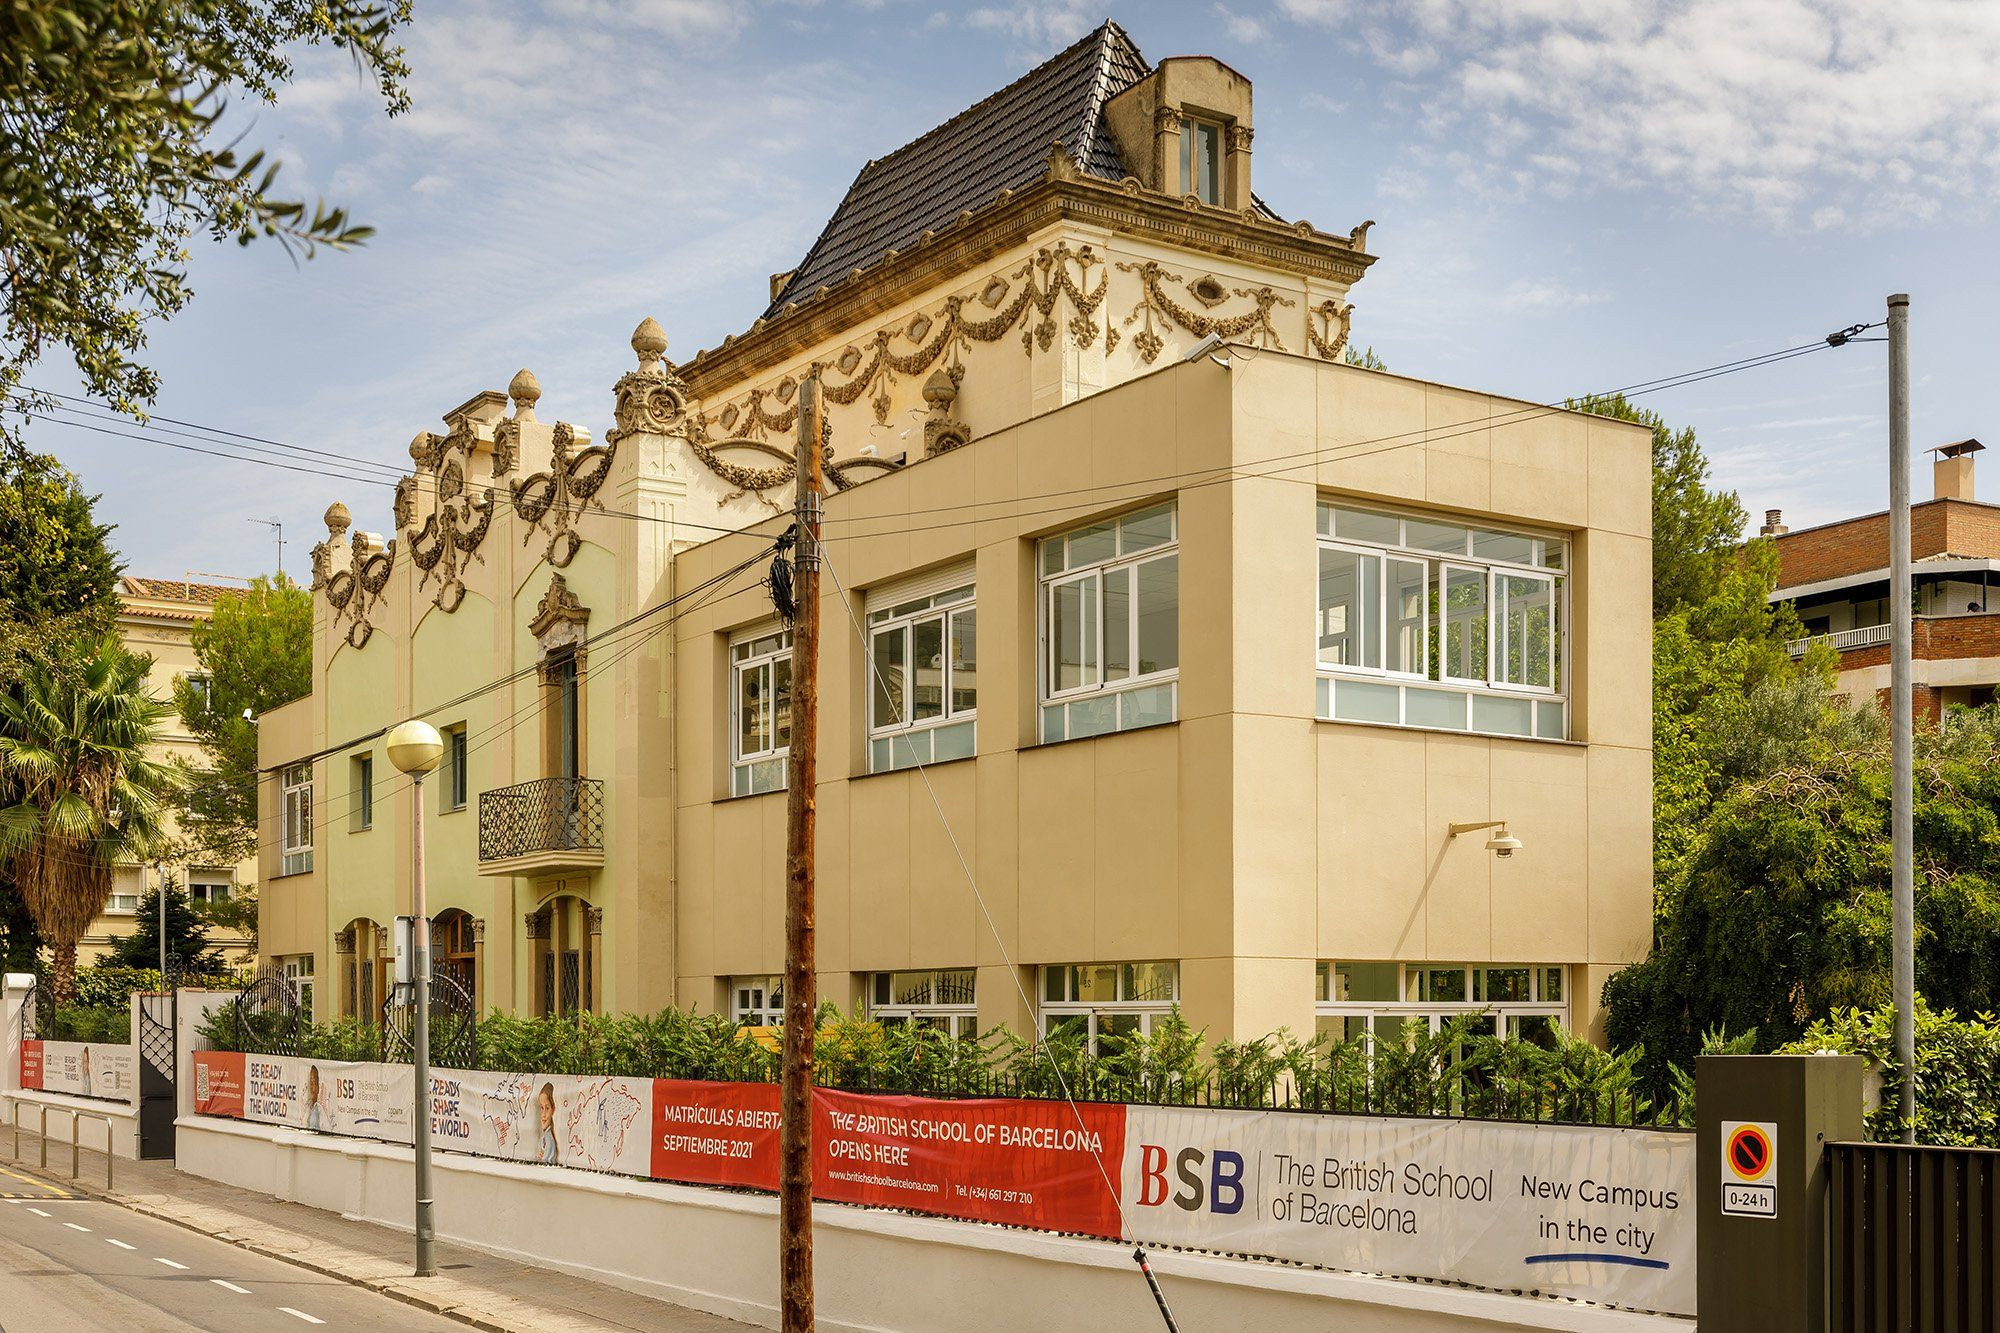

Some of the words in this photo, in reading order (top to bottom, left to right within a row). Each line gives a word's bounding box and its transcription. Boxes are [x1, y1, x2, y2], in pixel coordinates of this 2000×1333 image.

[251, 1063, 259, 1078] BE
[261, 1064, 282, 1080] READY
[251, 1081, 259, 1095] TO
[260, 1082, 296, 1100] CHALLENGE
[337, 1078, 354, 1099] BSB
[432, 1079, 461, 1097] READY
[250, 1098, 261, 1114] THE
[263, 1100, 288, 1118] WORLD
[434, 1098, 459, 1117] SHAPE
[665, 1103, 734, 1127] MATRÍCULAS
[439, 1118, 469, 1138] WORLD
[829, 1111, 856, 1131] THE
[856, 1114, 908, 1138] BRITISH
[911, 1119, 971, 1143] SCHOOL
[974, 1124, 996, 1144] OF
[1000, 1125, 1103, 1153] BARCELONA
[664, 1134, 727, 1156] SEPTIEMBRE
[730, 1141, 752, 1159] 2021
[829, 1139, 872, 1163] OPENS
[875, 1145, 910, 1167] HERE
[829, 1169, 938, 1193] www.britishschoolbarcelona.com
[1136, 1144, 1244, 1215] BSB
[1274, 1154, 1314, 1187] The
[1323, 1158, 1395, 1193] British
[1403, 1162, 1493, 1202] School
[955, 1185, 967, 1196] Tel.
[969, 1186, 987, 1201] (+34)
[989, 1189, 1001, 1200] 661
[1003, 1190, 1017, 1202] 297
[1019, 1192, 1033, 1204] 210
[1521, 1174, 1571, 1200] New
[1578, 1179, 1679, 1212] Campus
[1272, 1192, 1294, 1221] of
[1300, 1193, 1417, 1234] Barcelona
[1539, 1215, 1559, 1240] in
[1567, 1218, 1607, 1244] the
[1616, 1223, 1655, 1255] city
